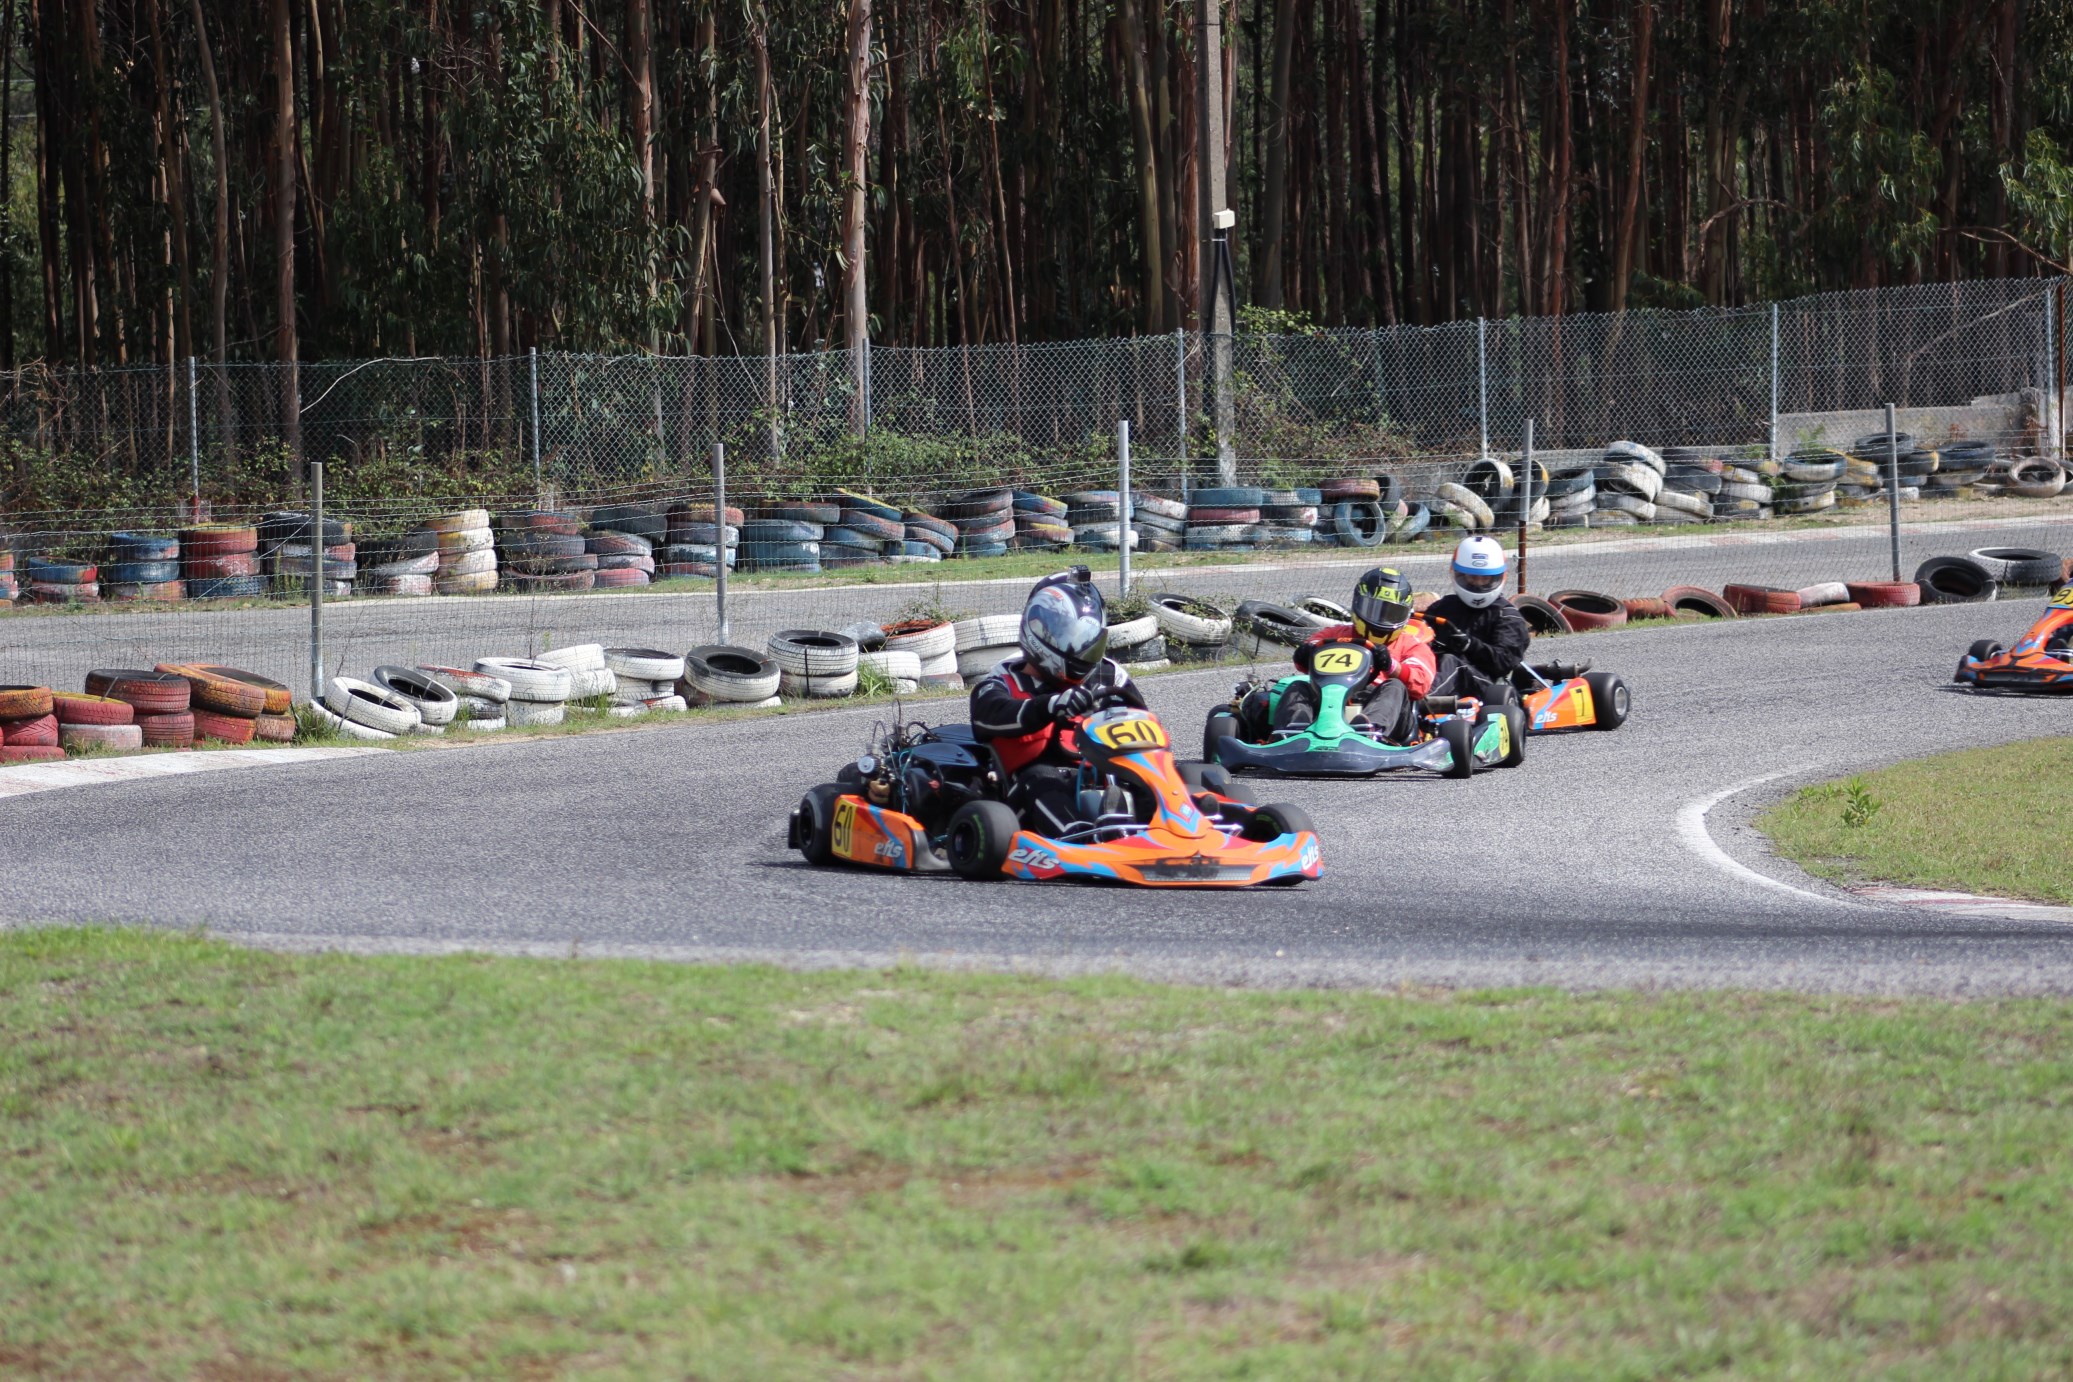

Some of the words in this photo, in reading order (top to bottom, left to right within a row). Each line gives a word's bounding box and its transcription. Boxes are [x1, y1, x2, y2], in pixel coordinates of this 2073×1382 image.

[1319, 653, 1353, 669] 74
[1106, 720, 1158, 746] 60
[834, 804, 853, 853] 60
